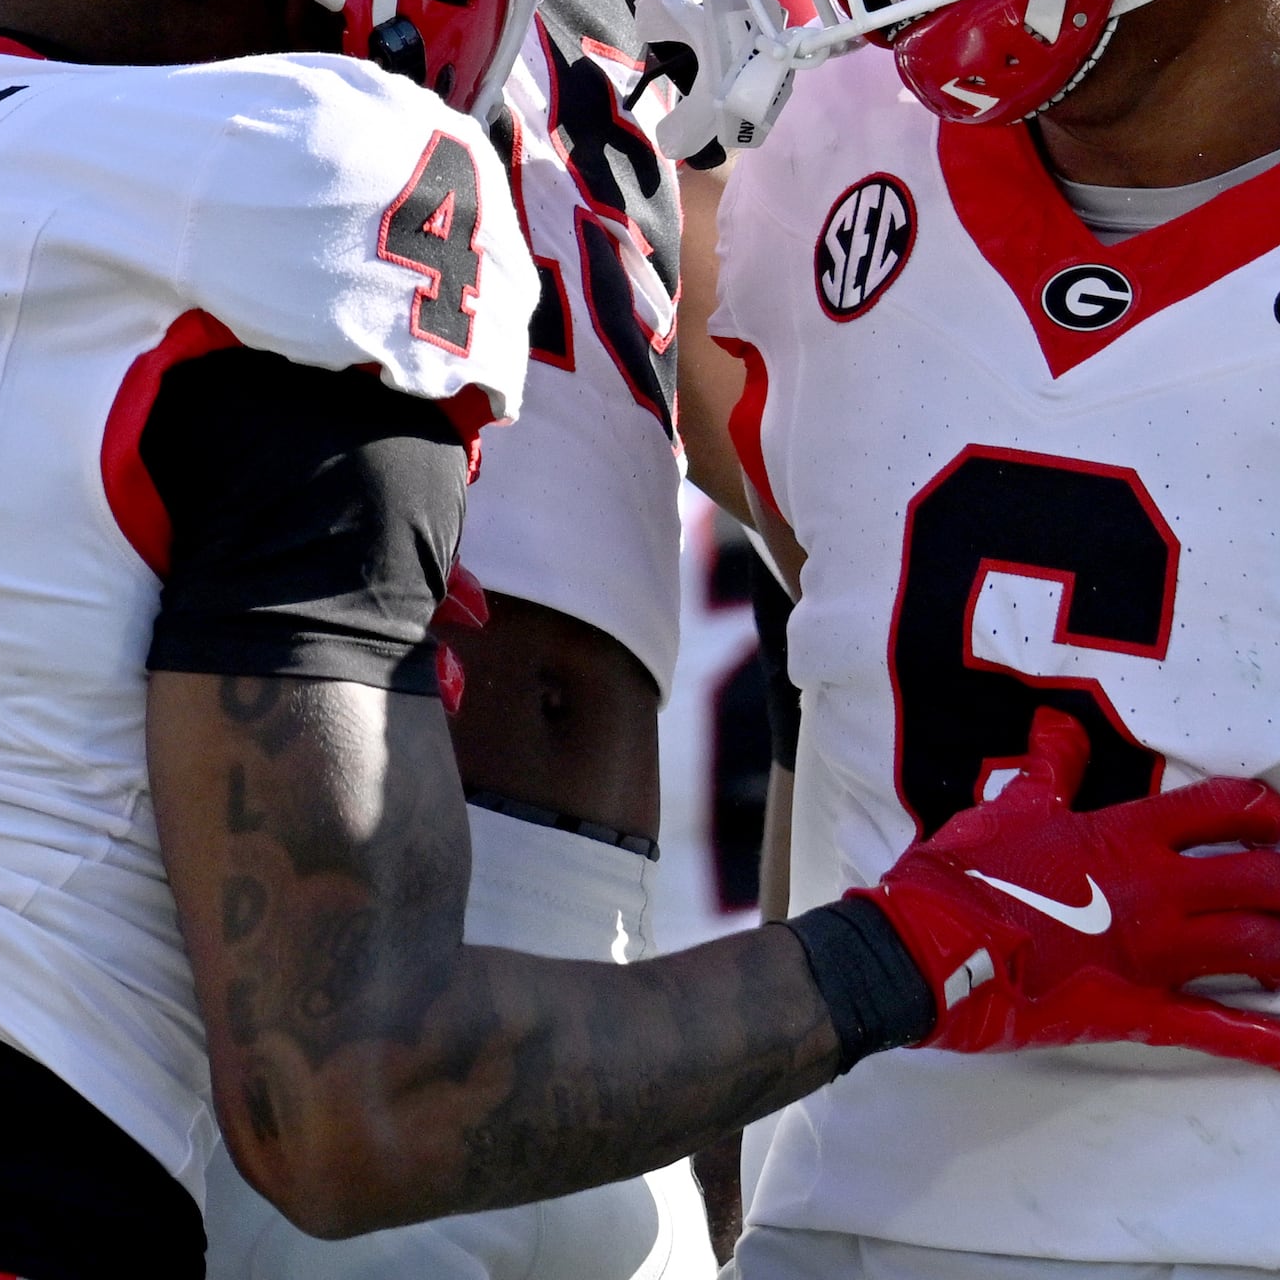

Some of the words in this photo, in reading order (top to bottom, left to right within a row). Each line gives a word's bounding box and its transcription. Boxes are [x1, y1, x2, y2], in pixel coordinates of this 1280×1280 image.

[376, 129, 484, 358] 4
[822, 180, 908, 311] SEC
[1043, 264, 1132, 331] G
[887, 443, 1181, 840] 6
